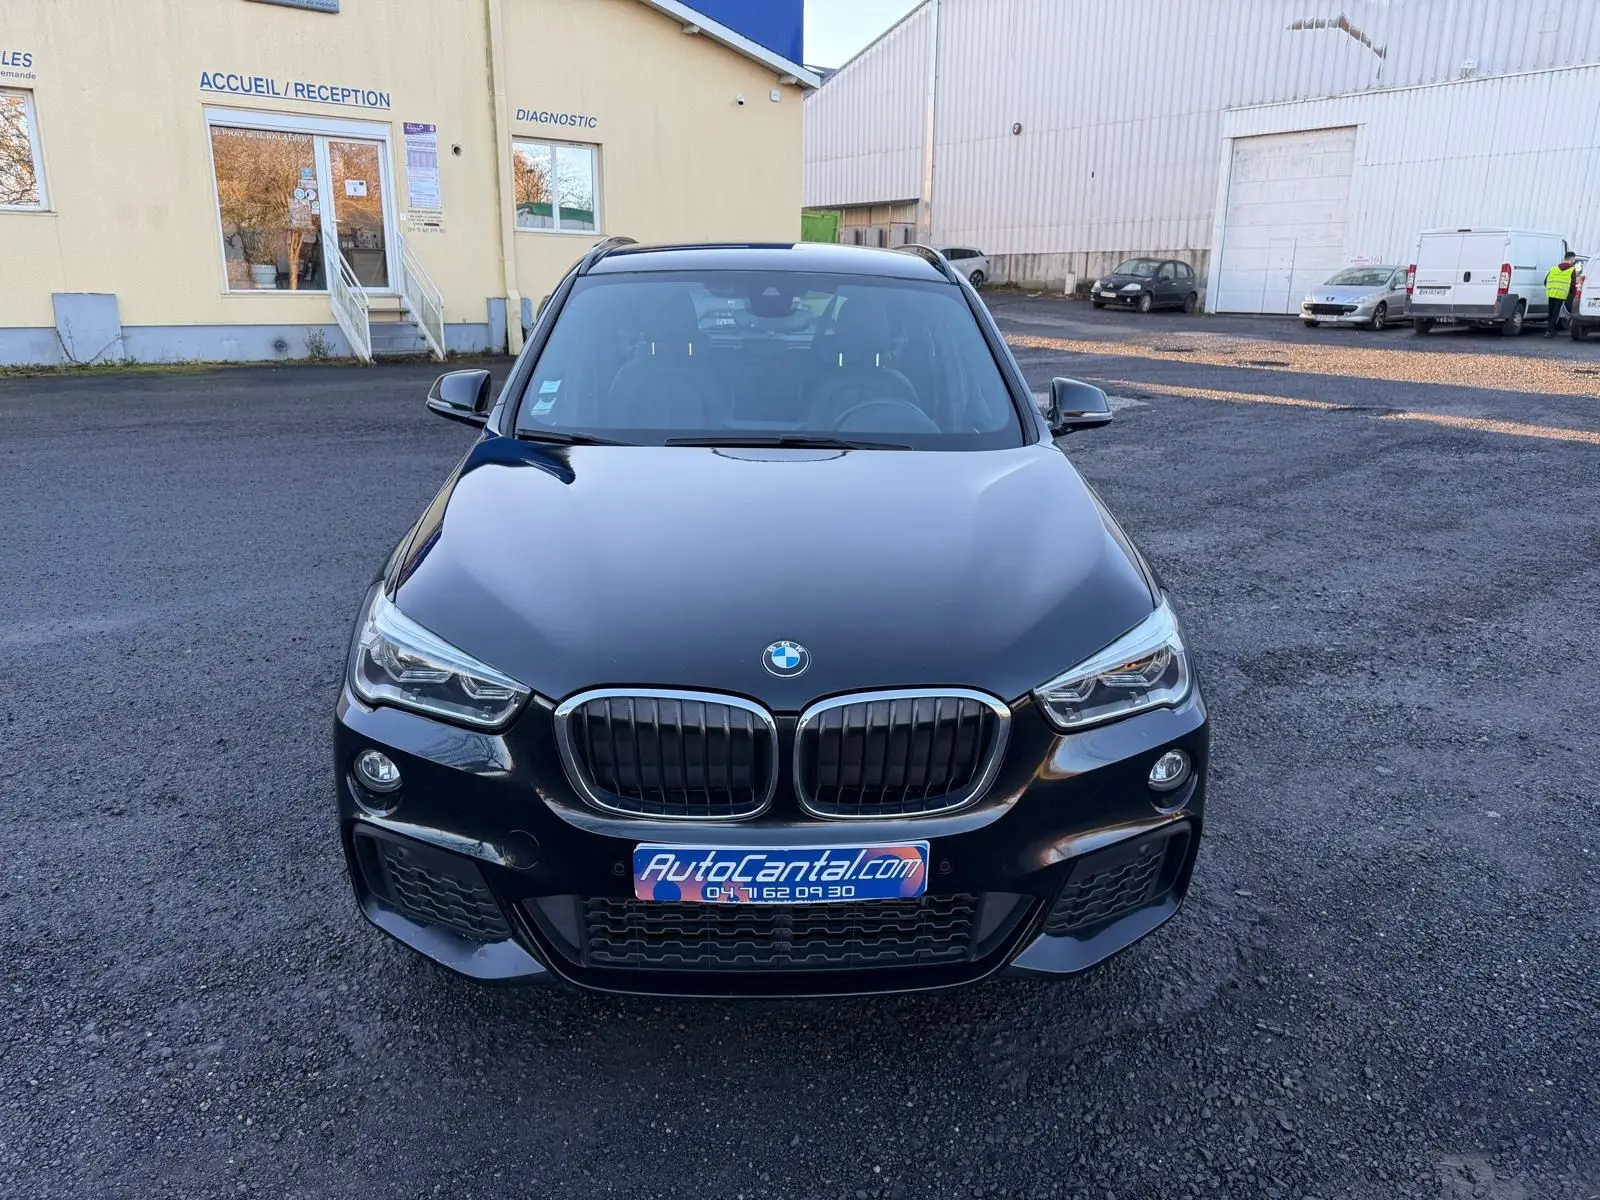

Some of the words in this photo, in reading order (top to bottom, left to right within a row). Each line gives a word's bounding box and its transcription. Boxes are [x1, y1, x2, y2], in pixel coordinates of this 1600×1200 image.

[1, 50, 33, 68] LES
[0, 70, 37, 80] emande
[199, 71, 280, 96] ACCUEIL
[294, 82, 391, 108] RECEPTION
[516, 108, 598, 129] DIAGNOSTIC
[640, 848, 922, 882] AutoCantal.com
[706, 887, 734, 899] 04
[740, 887, 758, 899] 71
[763, 887, 790, 899] 62
[796, 887, 822, 898] 09
[828, 886, 855, 898] 30
